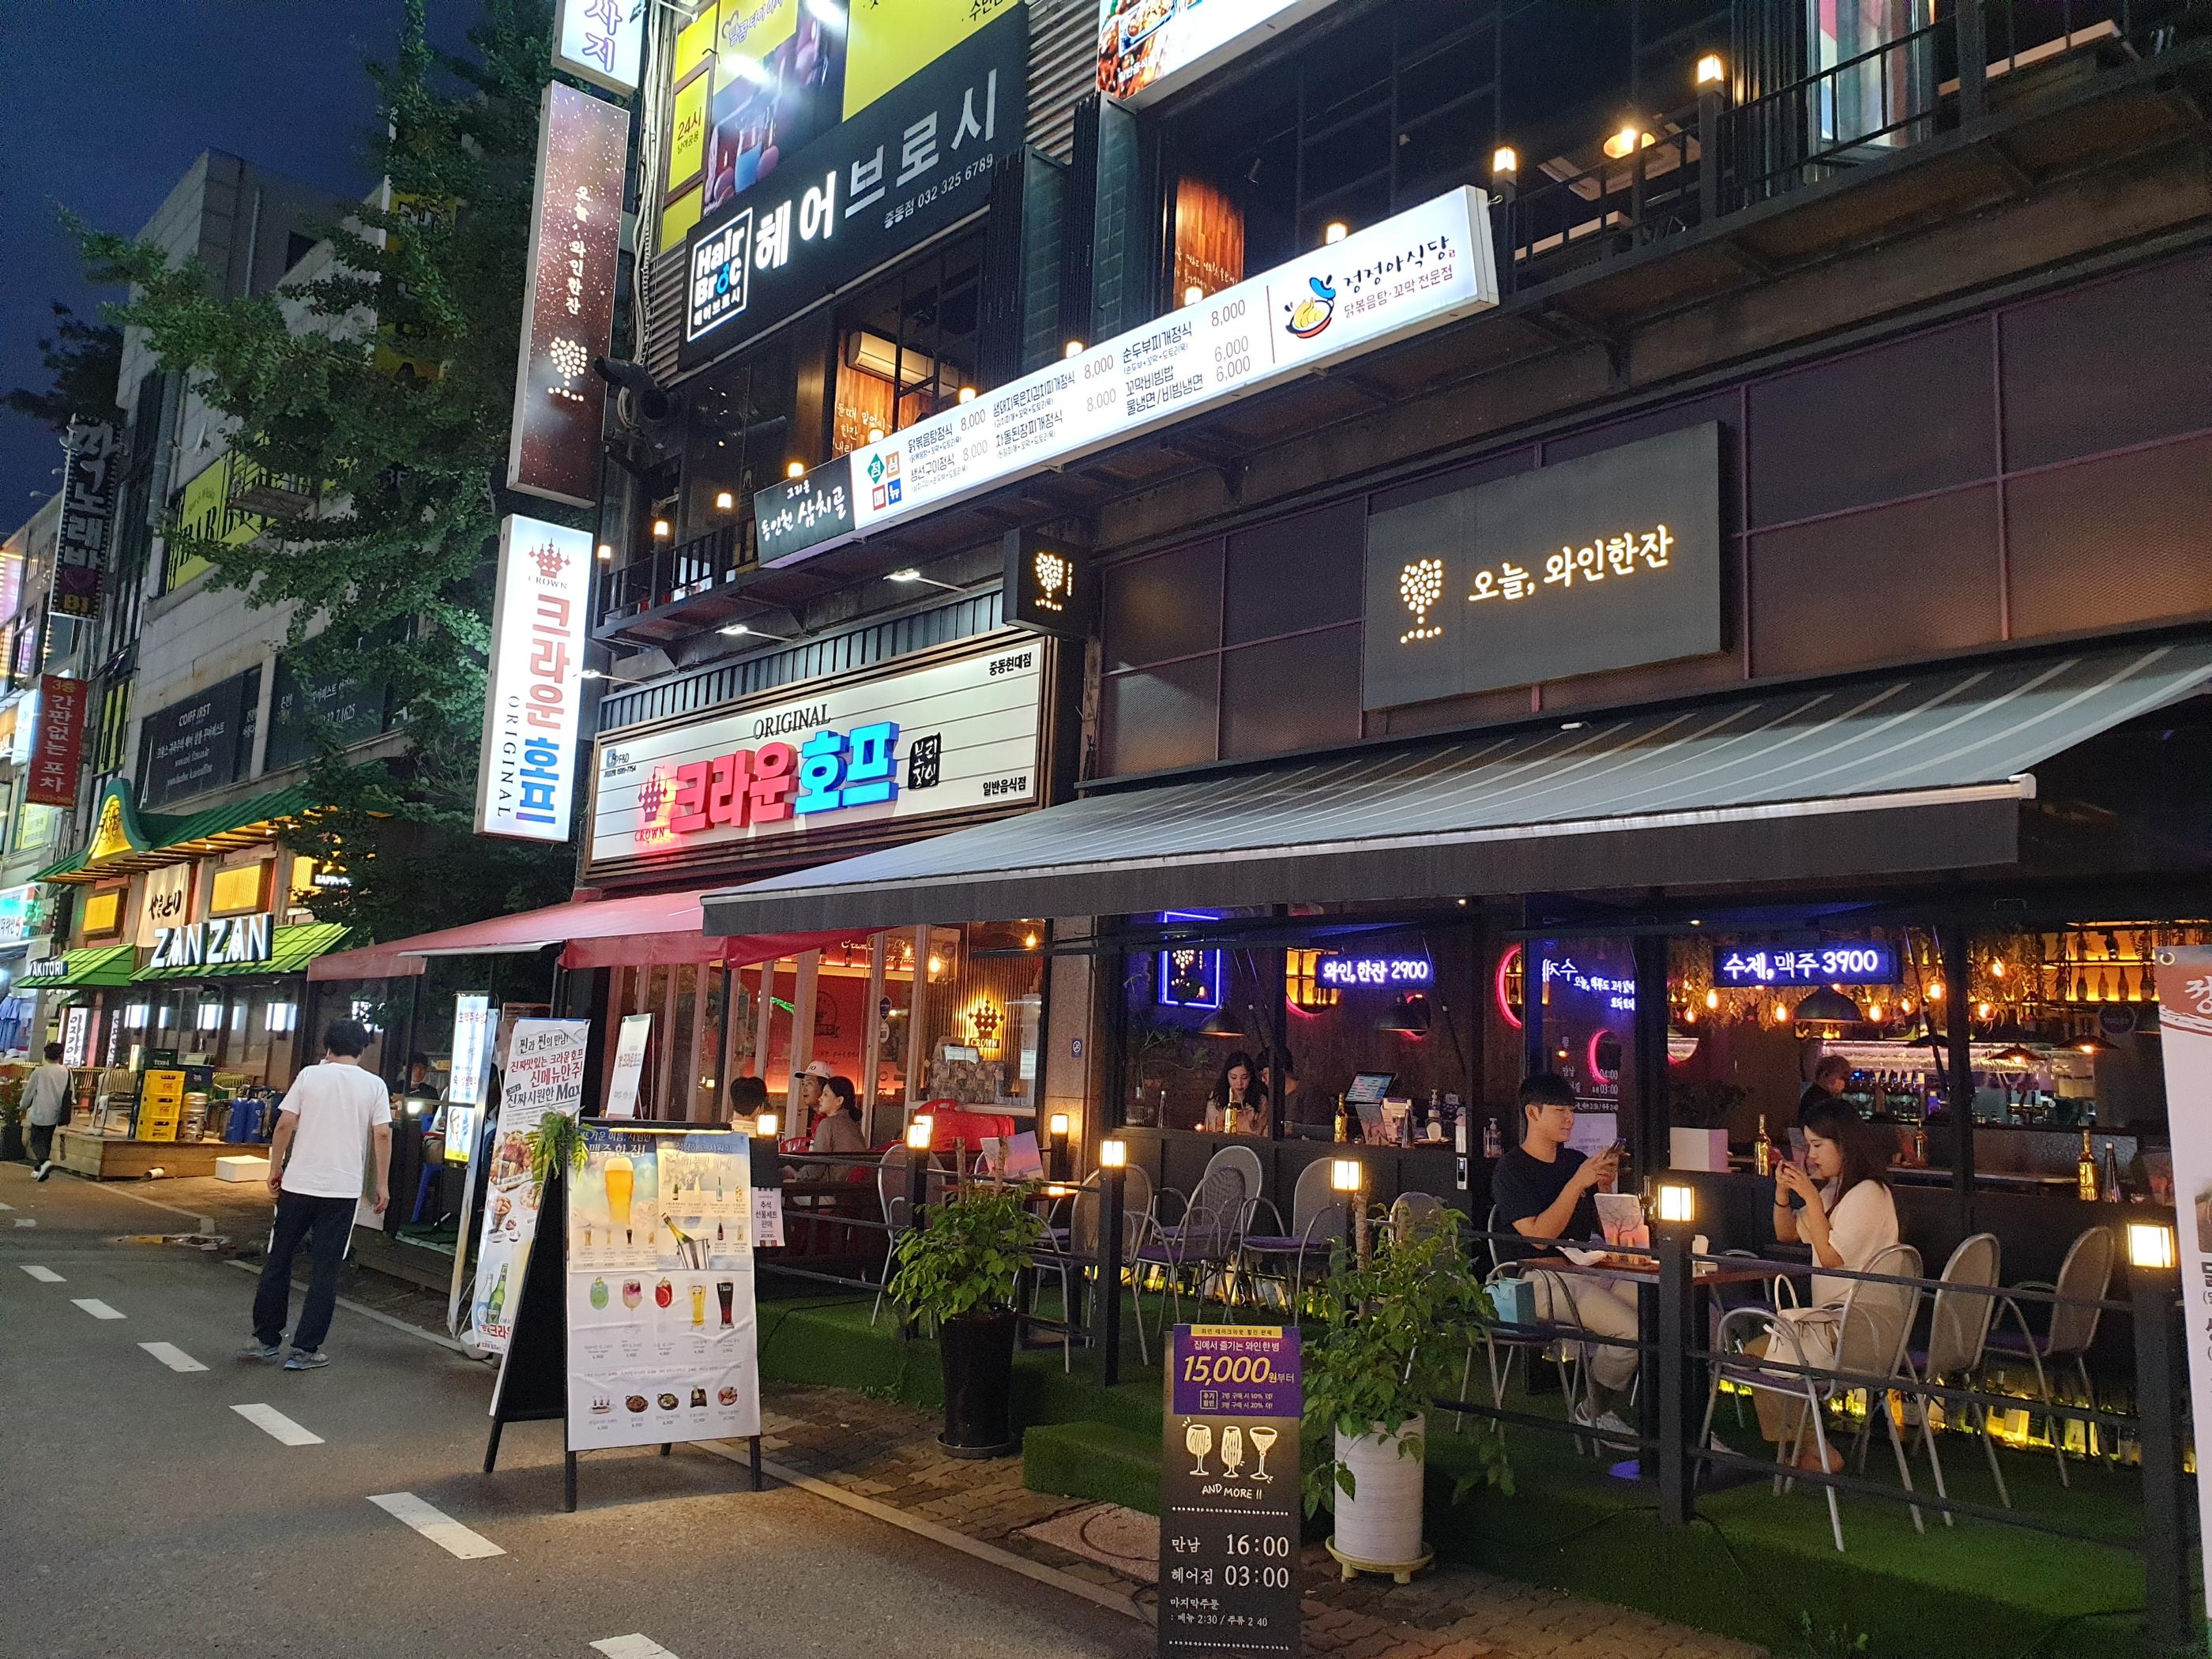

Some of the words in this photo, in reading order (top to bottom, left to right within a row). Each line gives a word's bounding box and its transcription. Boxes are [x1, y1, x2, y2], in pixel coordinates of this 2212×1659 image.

[677, 107, 702, 142] 24시
[884, 201, 915, 229] 중동점
[918, 186, 937, 209] 032
[942, 171, 961, 194] 325
[965, 153, 993, 180] 6789
[696, 226, 745, 280] Hair
[1343, 235, 1449, 294] 정정아식당
[566, 239, 587, 315] 와인한잔
[1418, 265, 1454, 290] 전문점
[1123, 321, 1191, 363] 순두부찌개정식
[1211, 299, 1245, 327] 8,000
[1084, 355, 1114, 379] 8,000
[1126, 364, 1173, 397] 꼬막비빔밥
[1214, 336, 1249, 363] 6,000
[1217, 356, 1251, 382] 6,000
[961, 409, 986, 431] 8,000
[911, 453, 955, 482] 생선구이정식
[1468, 562, 1535, 601] 오늘,
[1544, 525, 1674, 588] 와인한잔
[528, 574, 568, 589] CROWN
[988, 652, 1032, 676] 중동현대점
[752, 703, 832, 741] ORIGINAL
[497, 694, 521, 817] ORIGINAL
[669, 720, 901, 836] 크라운호프
[982, 776, 1026, 798] 일반음식점
[634, 827, 666, 843] CROWN
[1391, 961, 1428, 980] 2900
[1822, 949, 1877, 973] 3900
[971, 1038, 998, 1048] CROWN
[550, 1048, 583, 1064] 크라운호프
[555, 1082, 581, 1101] Max
[589, 1144, 611, 1157] 맥주
[615, 1144, 626, 1157] 한
[630, 1143, 646, 1158] 잔!
[1194, 1340, 1217, 1351] 집에서
[1220, 1341, 1243, 1352] 즐기는
[1245, 1342, 1262, 1352] 와인
[1202, 1484, 1222, 1495] AND
[1224, 1487, 1252, 1499] MORE
[1172, 1536, 1200, 1553] 만남
[1226, 1533, 1289, 1557] 16:00
[1171, 1567, 1213, 1586] 헤어짐
[1225, 1565, 1289, 1588] 03:00
[1170, 1597, 1220, 1610] 마지막주문
[1198, 1614, 1217, 1624] 2:30
